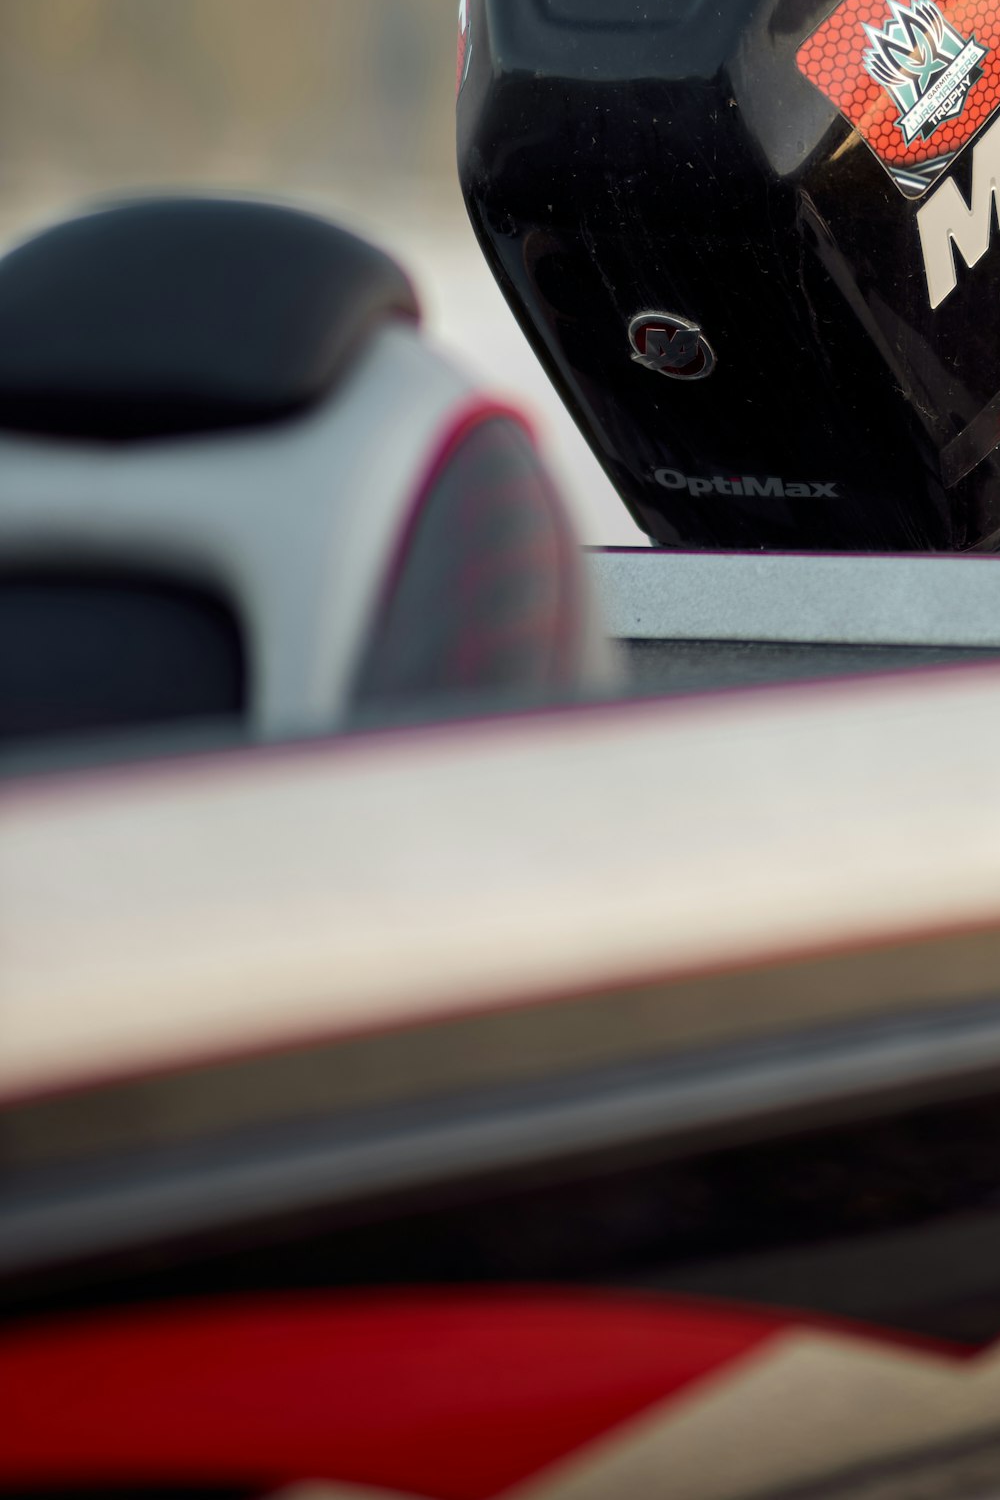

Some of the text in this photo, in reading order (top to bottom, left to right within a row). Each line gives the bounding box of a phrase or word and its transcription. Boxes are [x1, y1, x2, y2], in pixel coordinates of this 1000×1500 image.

[910, 52, 979, 132] LURE MASTERS
[927, 71, 952, 100] GARMIN
[928, 74, 971, 125] TROPHY
[654, 468, 839, 497] OptiMax
